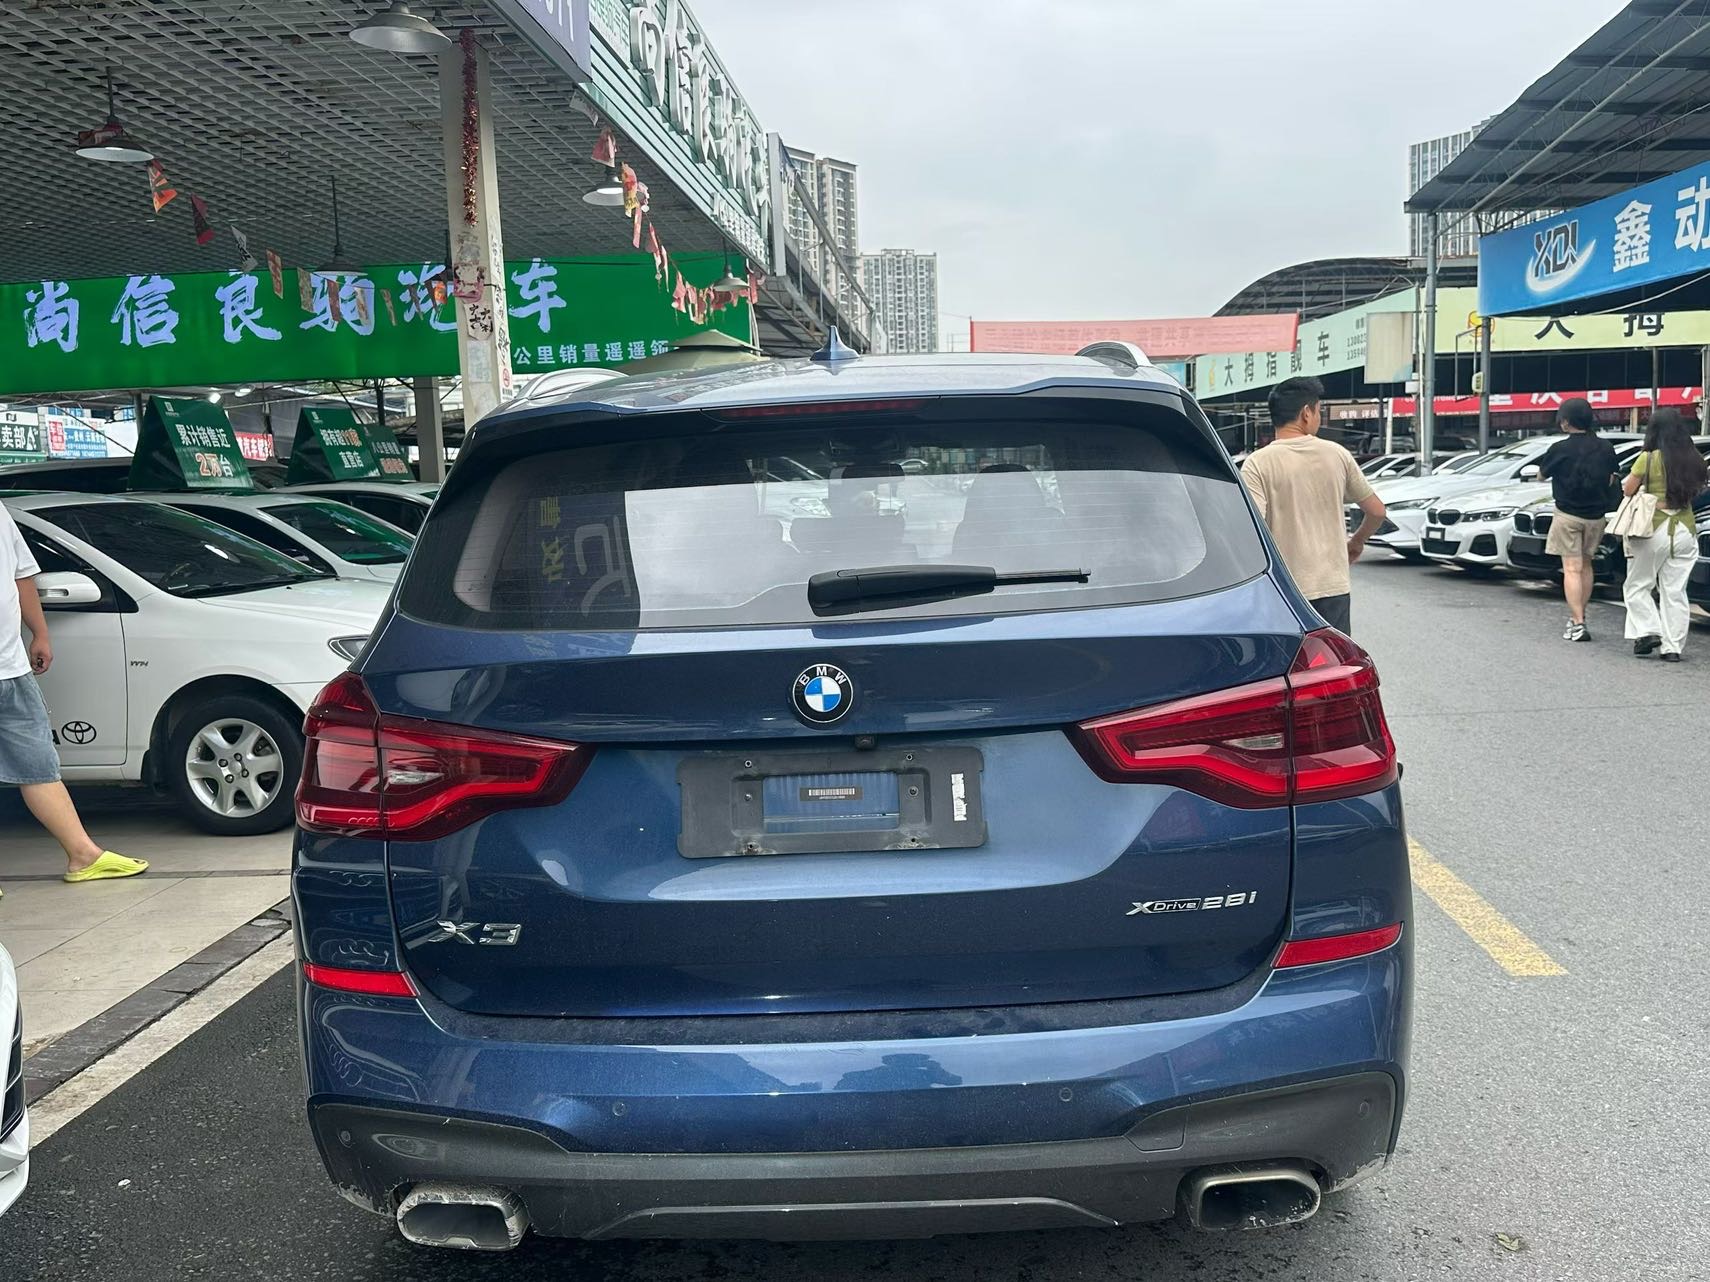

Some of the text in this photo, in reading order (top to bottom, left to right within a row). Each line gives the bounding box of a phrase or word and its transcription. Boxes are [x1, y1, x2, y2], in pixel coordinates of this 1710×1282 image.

[1613, 176, 1710, 272] 鑫动
[175, 424, 231, 448] 累计销售近
[195, 453, 233, 477] 2万台
[799, 666, 847, 686] BMW
[428, 920, 521, 945] X3
